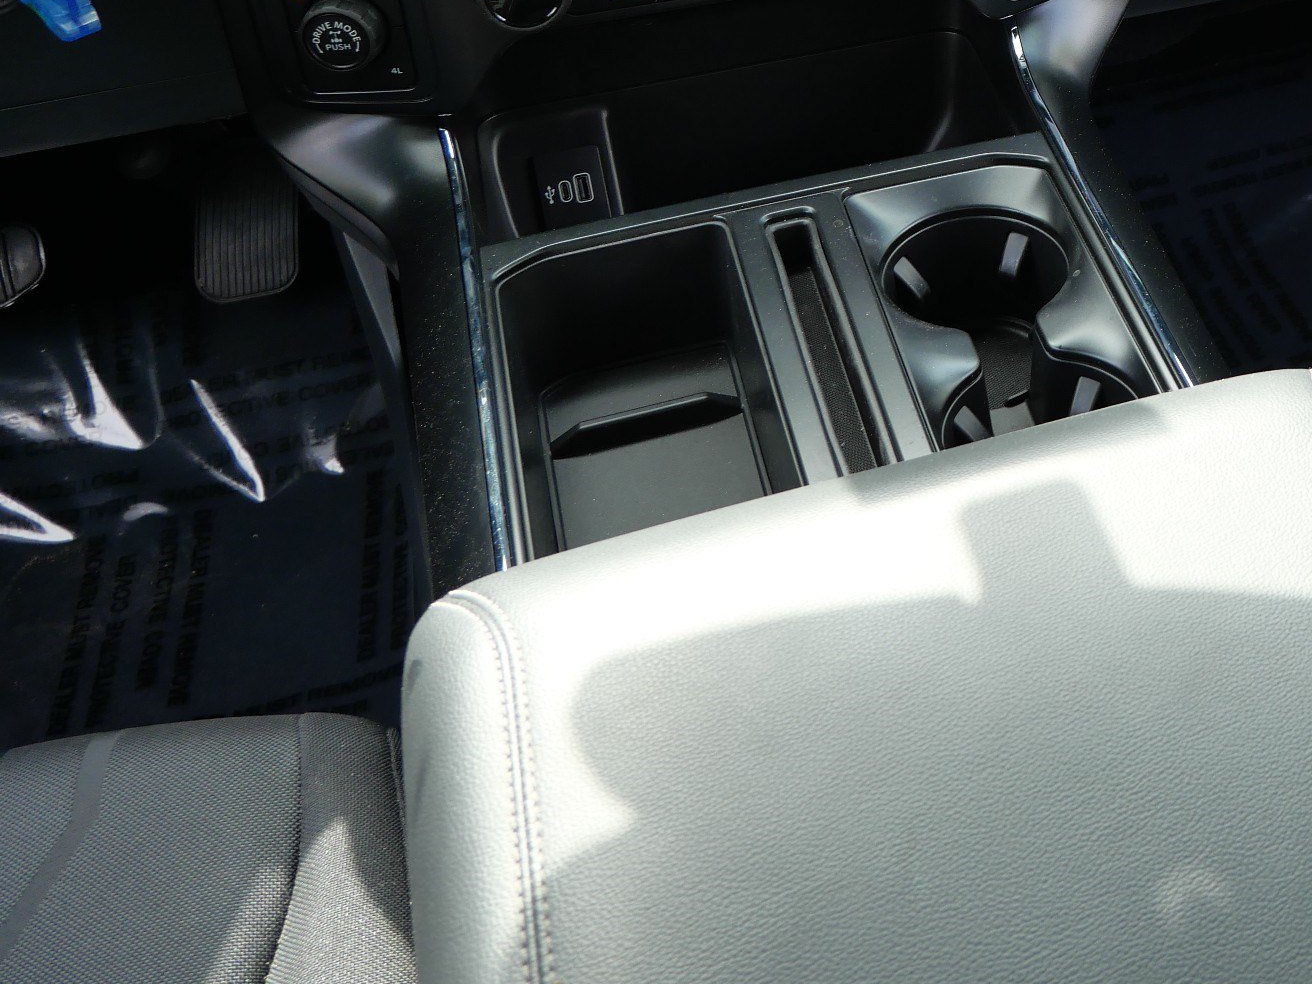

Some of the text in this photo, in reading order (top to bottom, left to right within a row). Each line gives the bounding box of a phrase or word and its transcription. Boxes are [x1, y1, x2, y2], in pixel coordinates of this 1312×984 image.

[312, 21, 361, 44] DRIVE MODE
[325, 43, 351, 51] PUSH
